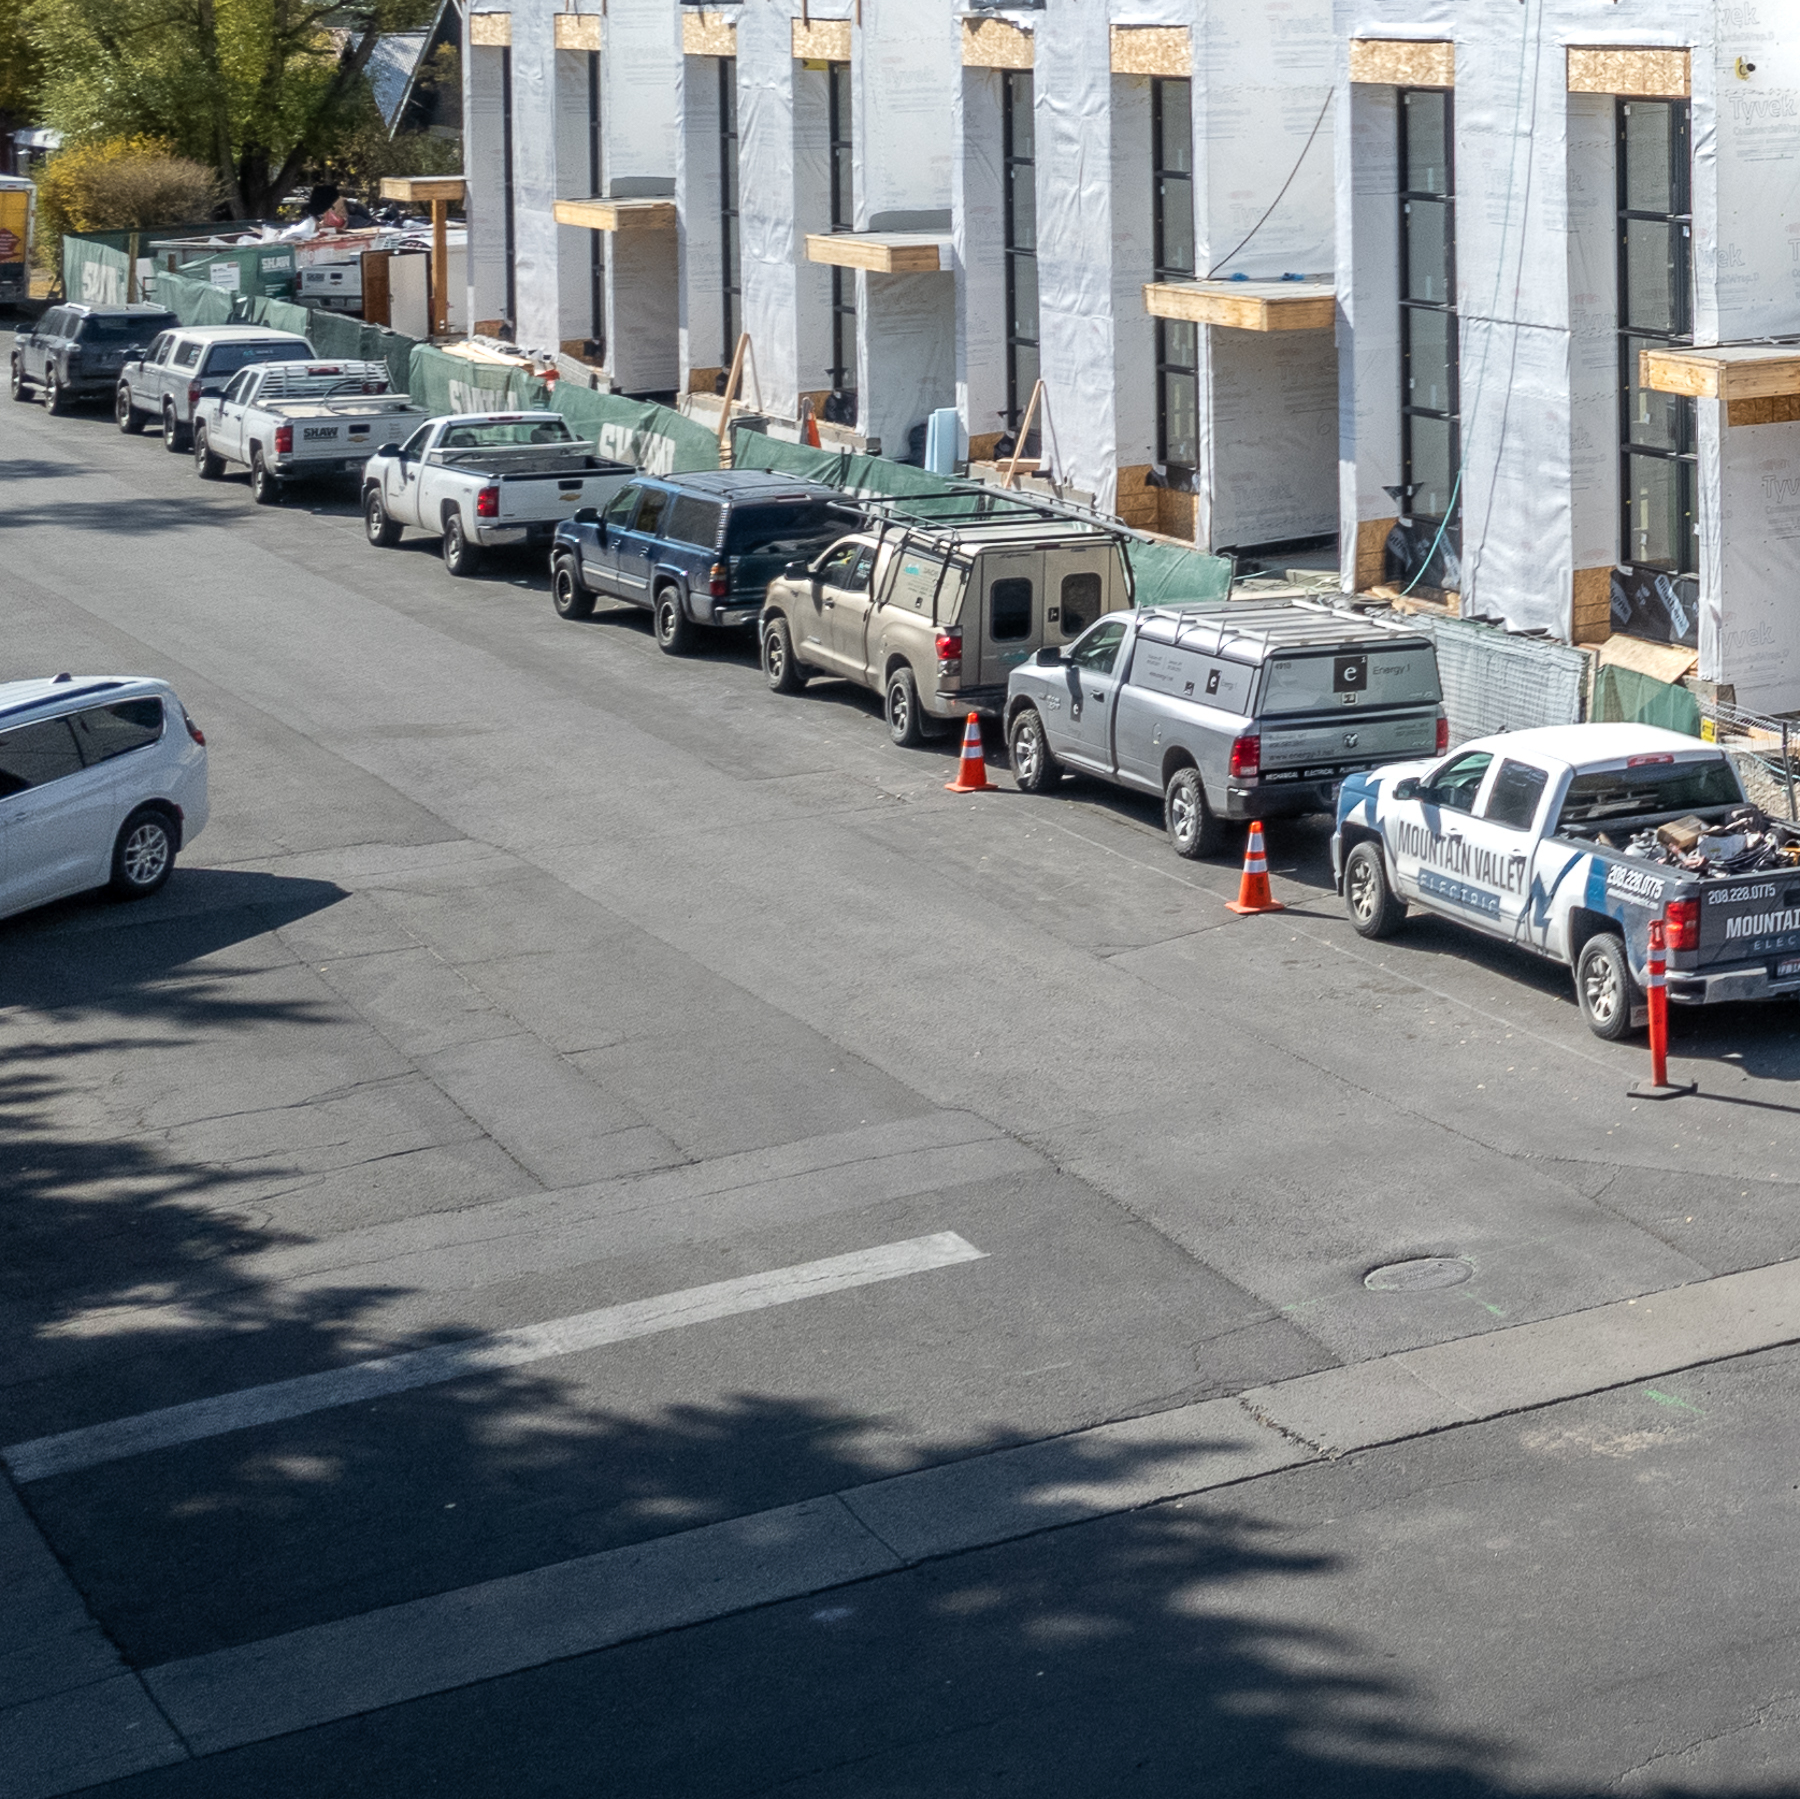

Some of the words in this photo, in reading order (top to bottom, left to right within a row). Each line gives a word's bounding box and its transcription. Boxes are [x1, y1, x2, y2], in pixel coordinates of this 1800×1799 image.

[1729, 95, 1797, 125] Tyvek
[262, 256, 290, 270] SHAW
[304, 427, 339, 440] SHAW
[1373, 667, 1404, 676] Energy
[1265, 771, 1299, 781] MECHANICAL
[1304, 768, 1334, 777] ELECTRICAL
[1398, 820, 1471, 876] MOUNTAIN
[1474, 847, 1526, 895] VALLEY
[1607, 864, 1665, 899] 208.228.0775
[1420, 874, 1498, 912] ELECTRIC
[1708, 883, 1776, 905] 208.228.0775
